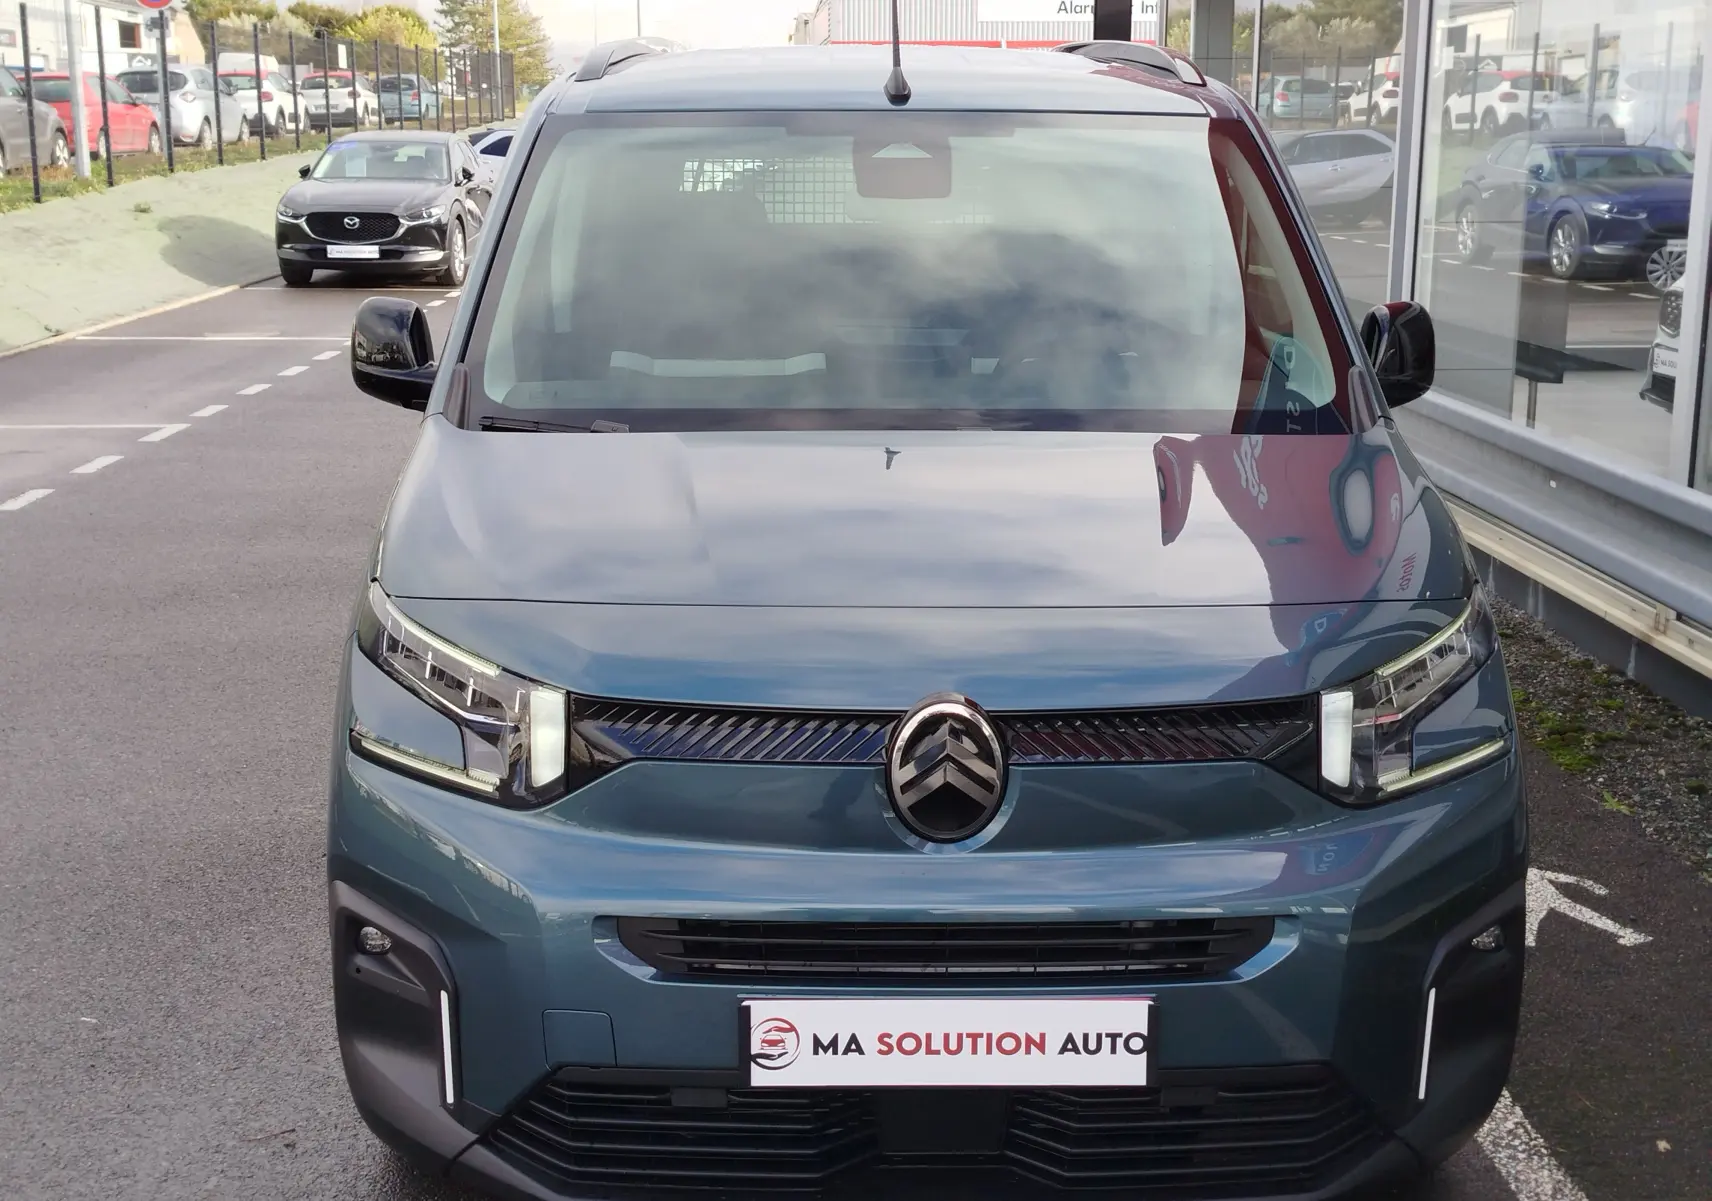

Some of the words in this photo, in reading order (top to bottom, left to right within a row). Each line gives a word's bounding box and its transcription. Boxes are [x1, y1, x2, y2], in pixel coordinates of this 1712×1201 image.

[812, 1032, 866, 1056] MA
[876, 1031, 1046, 1056] SOLUTION
[1057, 1031, 1148, 1056] AUTO
